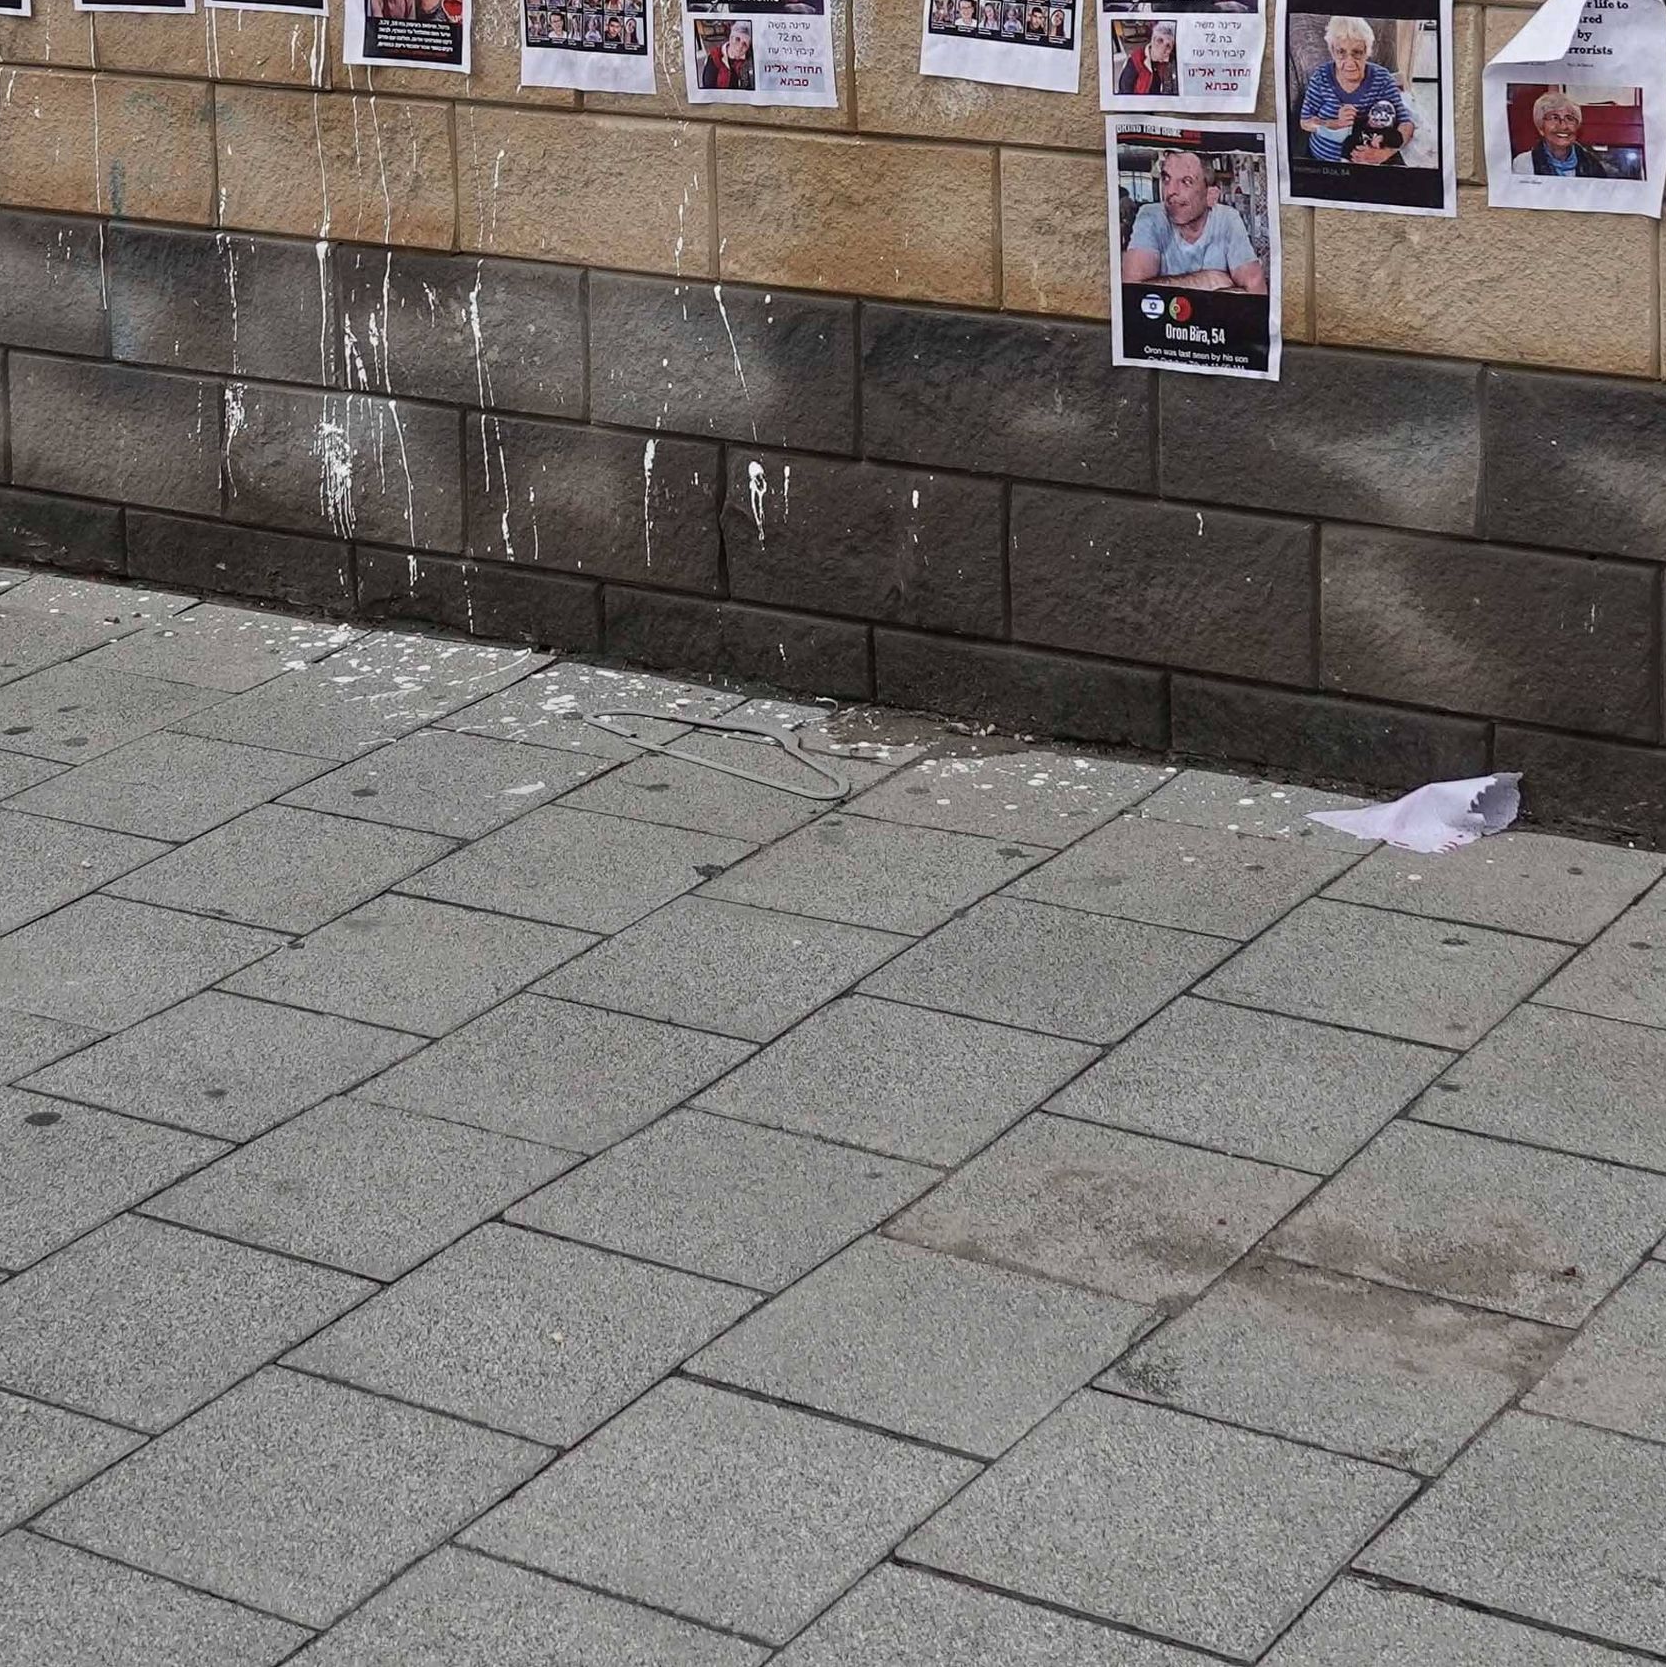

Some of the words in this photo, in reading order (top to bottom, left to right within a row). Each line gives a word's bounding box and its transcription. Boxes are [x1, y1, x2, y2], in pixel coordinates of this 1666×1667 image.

[1165, 323, 1188, 340] Oron
[1189, 325, 1210, 344] Bira,
[1211, 327, 1225, 344] 54
